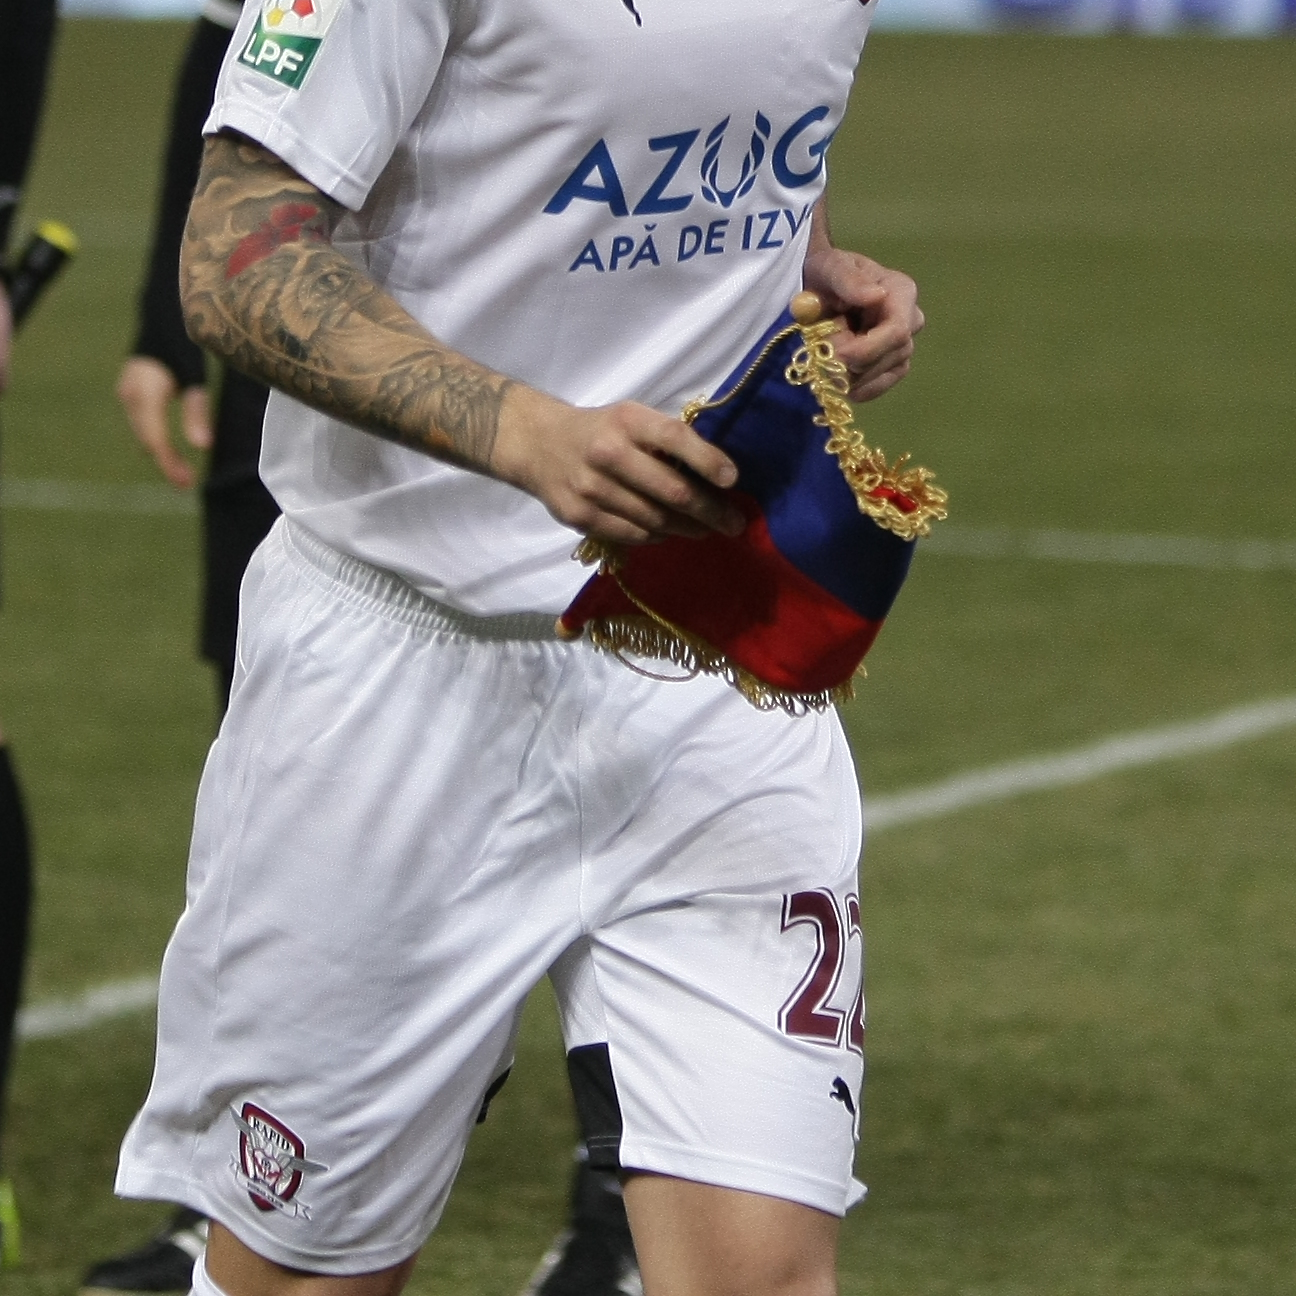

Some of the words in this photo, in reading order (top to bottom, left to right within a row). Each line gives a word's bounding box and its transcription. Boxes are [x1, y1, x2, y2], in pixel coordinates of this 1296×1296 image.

[242, 32, 304, 76] LPF
[568, 223, 661, 272] APĂ
[677, 218, 731, 262] DE
[253, 1116, 290, 1151] RAPID
